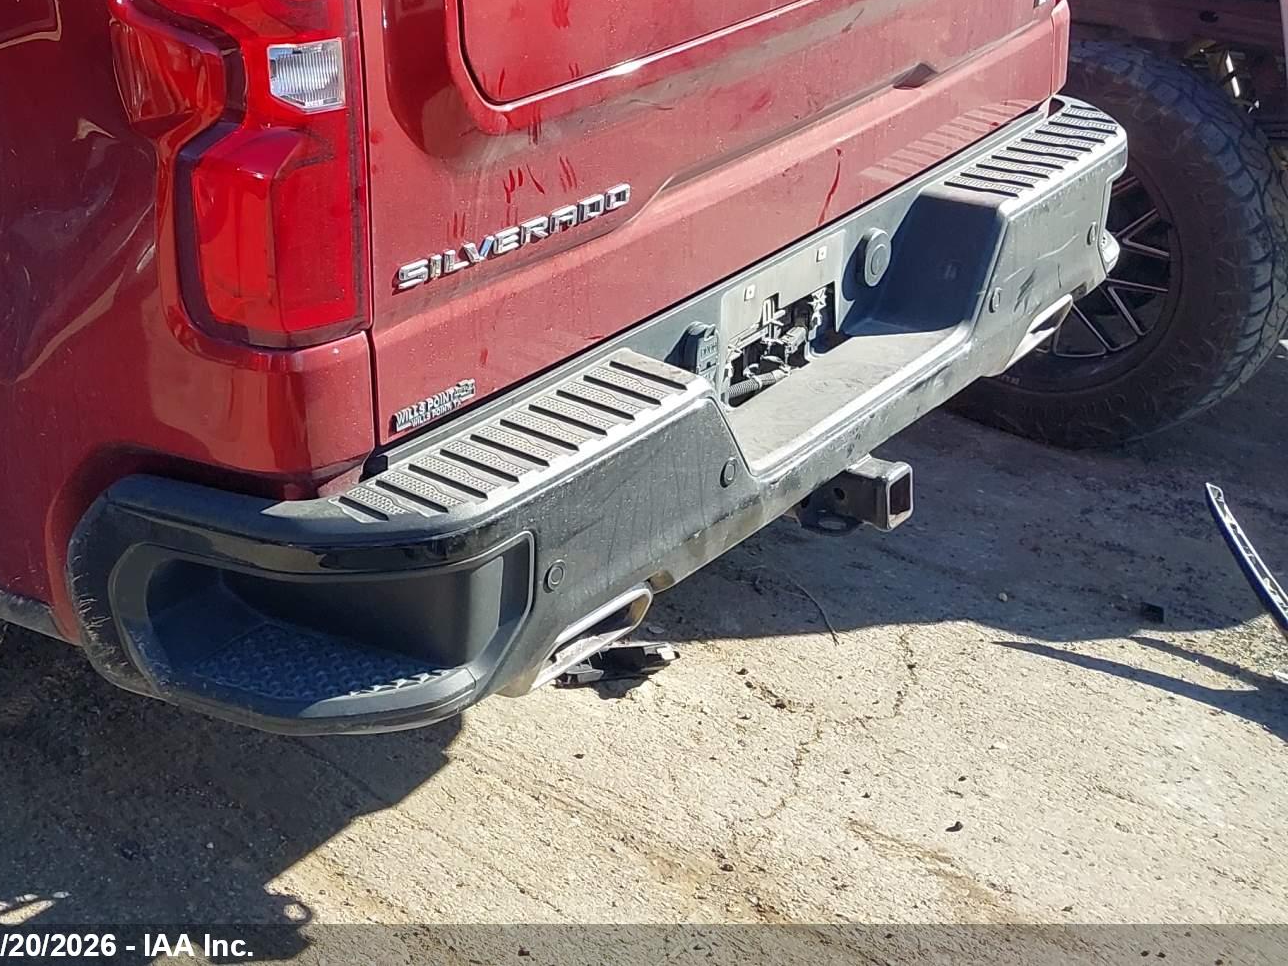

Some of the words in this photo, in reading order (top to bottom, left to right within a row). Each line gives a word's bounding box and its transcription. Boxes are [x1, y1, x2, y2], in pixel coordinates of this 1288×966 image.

[395, 183, 631, 291] SILVERADO
[395, 401, 426, 425] WILLS
[426, 387, 455, 411] POINT
